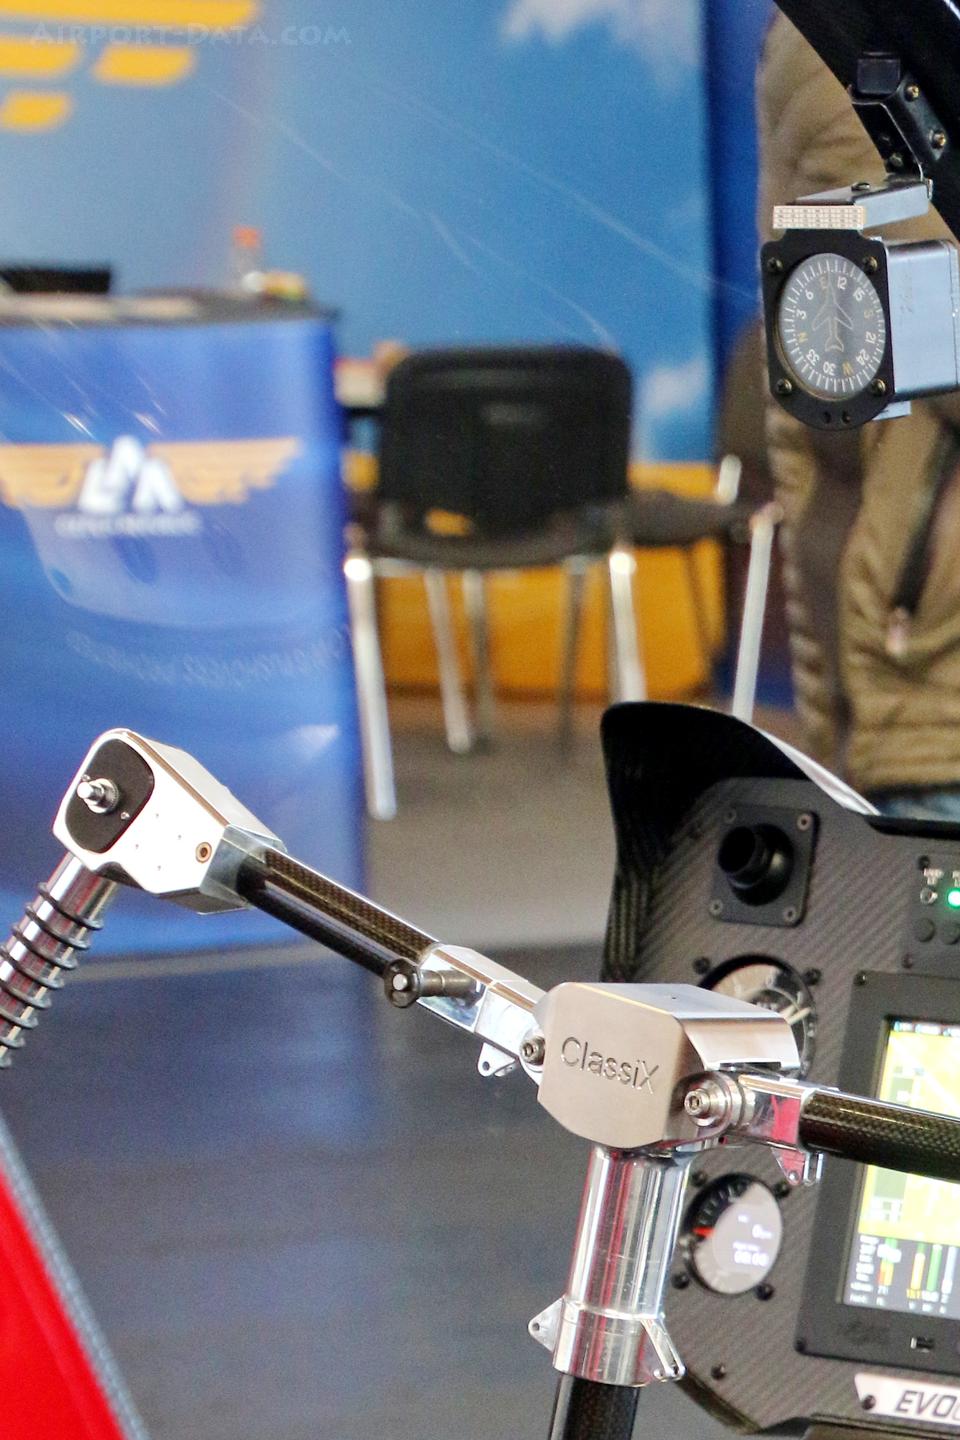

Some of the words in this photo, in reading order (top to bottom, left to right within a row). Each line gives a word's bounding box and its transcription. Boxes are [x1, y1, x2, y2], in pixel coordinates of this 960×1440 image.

[837, 276, 848, 290] 12
[806, 289, 814, 301] 6
[853, 288, 865, 302] 15
[796, 309, 807, 320] 3
[865, 331, 876, 345] 21
[806, 349, 820, 366] 33
[856, 349, 870, 366] 24
[823, 360, 836, 376] 30
[561, 1036, 660, 1095] ClassiX
